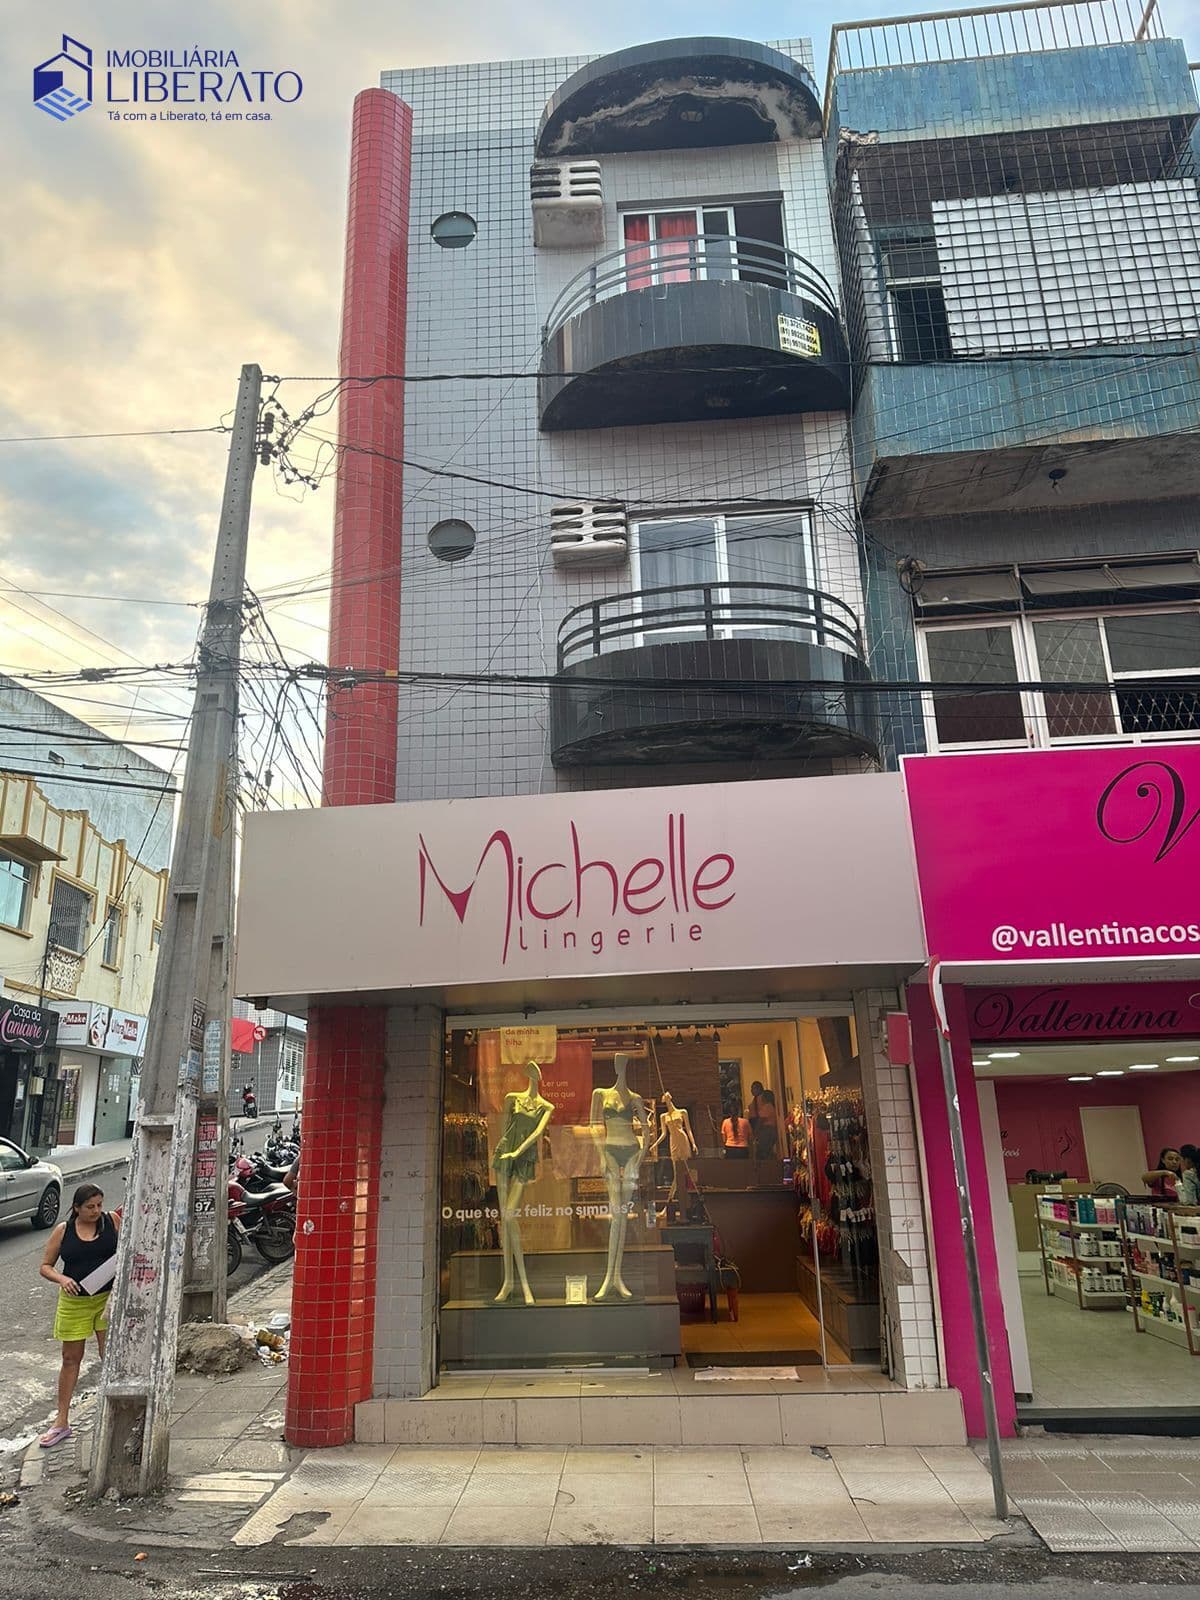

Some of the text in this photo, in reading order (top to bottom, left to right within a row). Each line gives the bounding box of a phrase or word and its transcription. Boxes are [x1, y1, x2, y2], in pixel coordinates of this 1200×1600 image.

[418, 813, 736, 965] Michelle
[519, 923, 703, 955] lingerie
[991, 921, 1200, 952] @vallentinacos
[13, 1004, 42, 1021] Casa da
[974, 988, 1184, 1036] Vallentina
[541, 1080, 555, 1088] Ler
[560, 1091, 576, 1099] que
[441, 1206, 453, 1219] O
[455, 1208, 483, 1223] que
[484, 1206, 499, 1219] te
[524, 1203, 553, 1217] feliz
[555, 1205, 573, 1217] no
